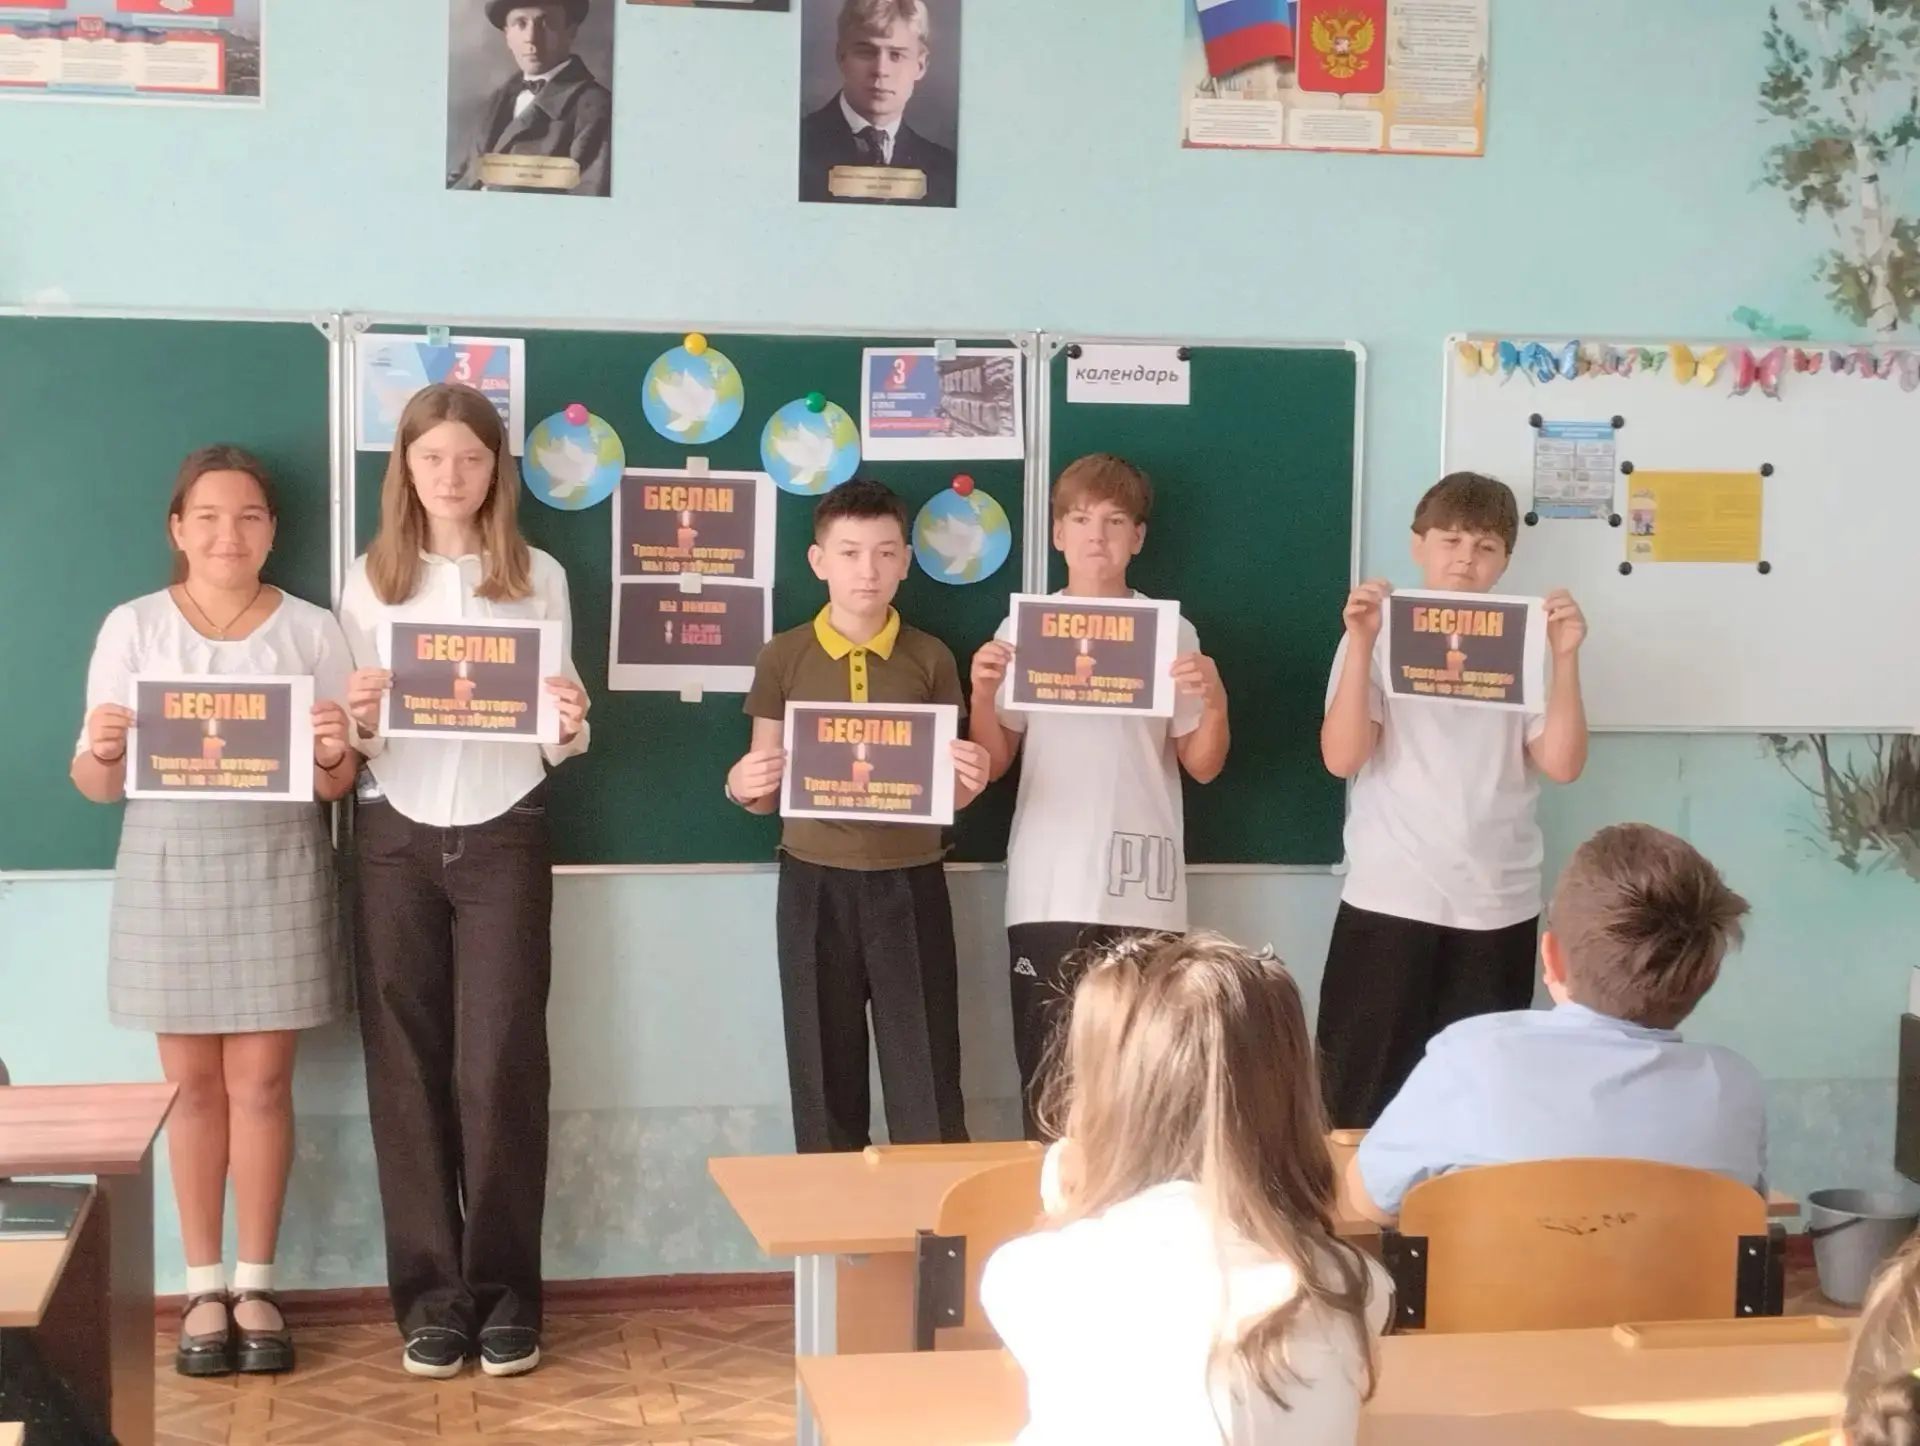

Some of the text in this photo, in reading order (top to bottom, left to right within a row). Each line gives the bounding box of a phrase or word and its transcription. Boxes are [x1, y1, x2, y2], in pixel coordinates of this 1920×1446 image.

[455, 352, 471, 380] 3
[893, 359, 907, 385] 3
[1075, 365, 1179, 386] календарь
[643, 485, 734, 513] БЕСЛАН
[1041, 612, 1135, 642] БЕСЛАН
[1411, 606, 1504, 637] БЕСЛАН
[416, 633, 517, 664] БЕСЛАН
[163, 691, 267, 721] БЕСЛАН
[817, 716, 913, 746] БЕСЛАН
